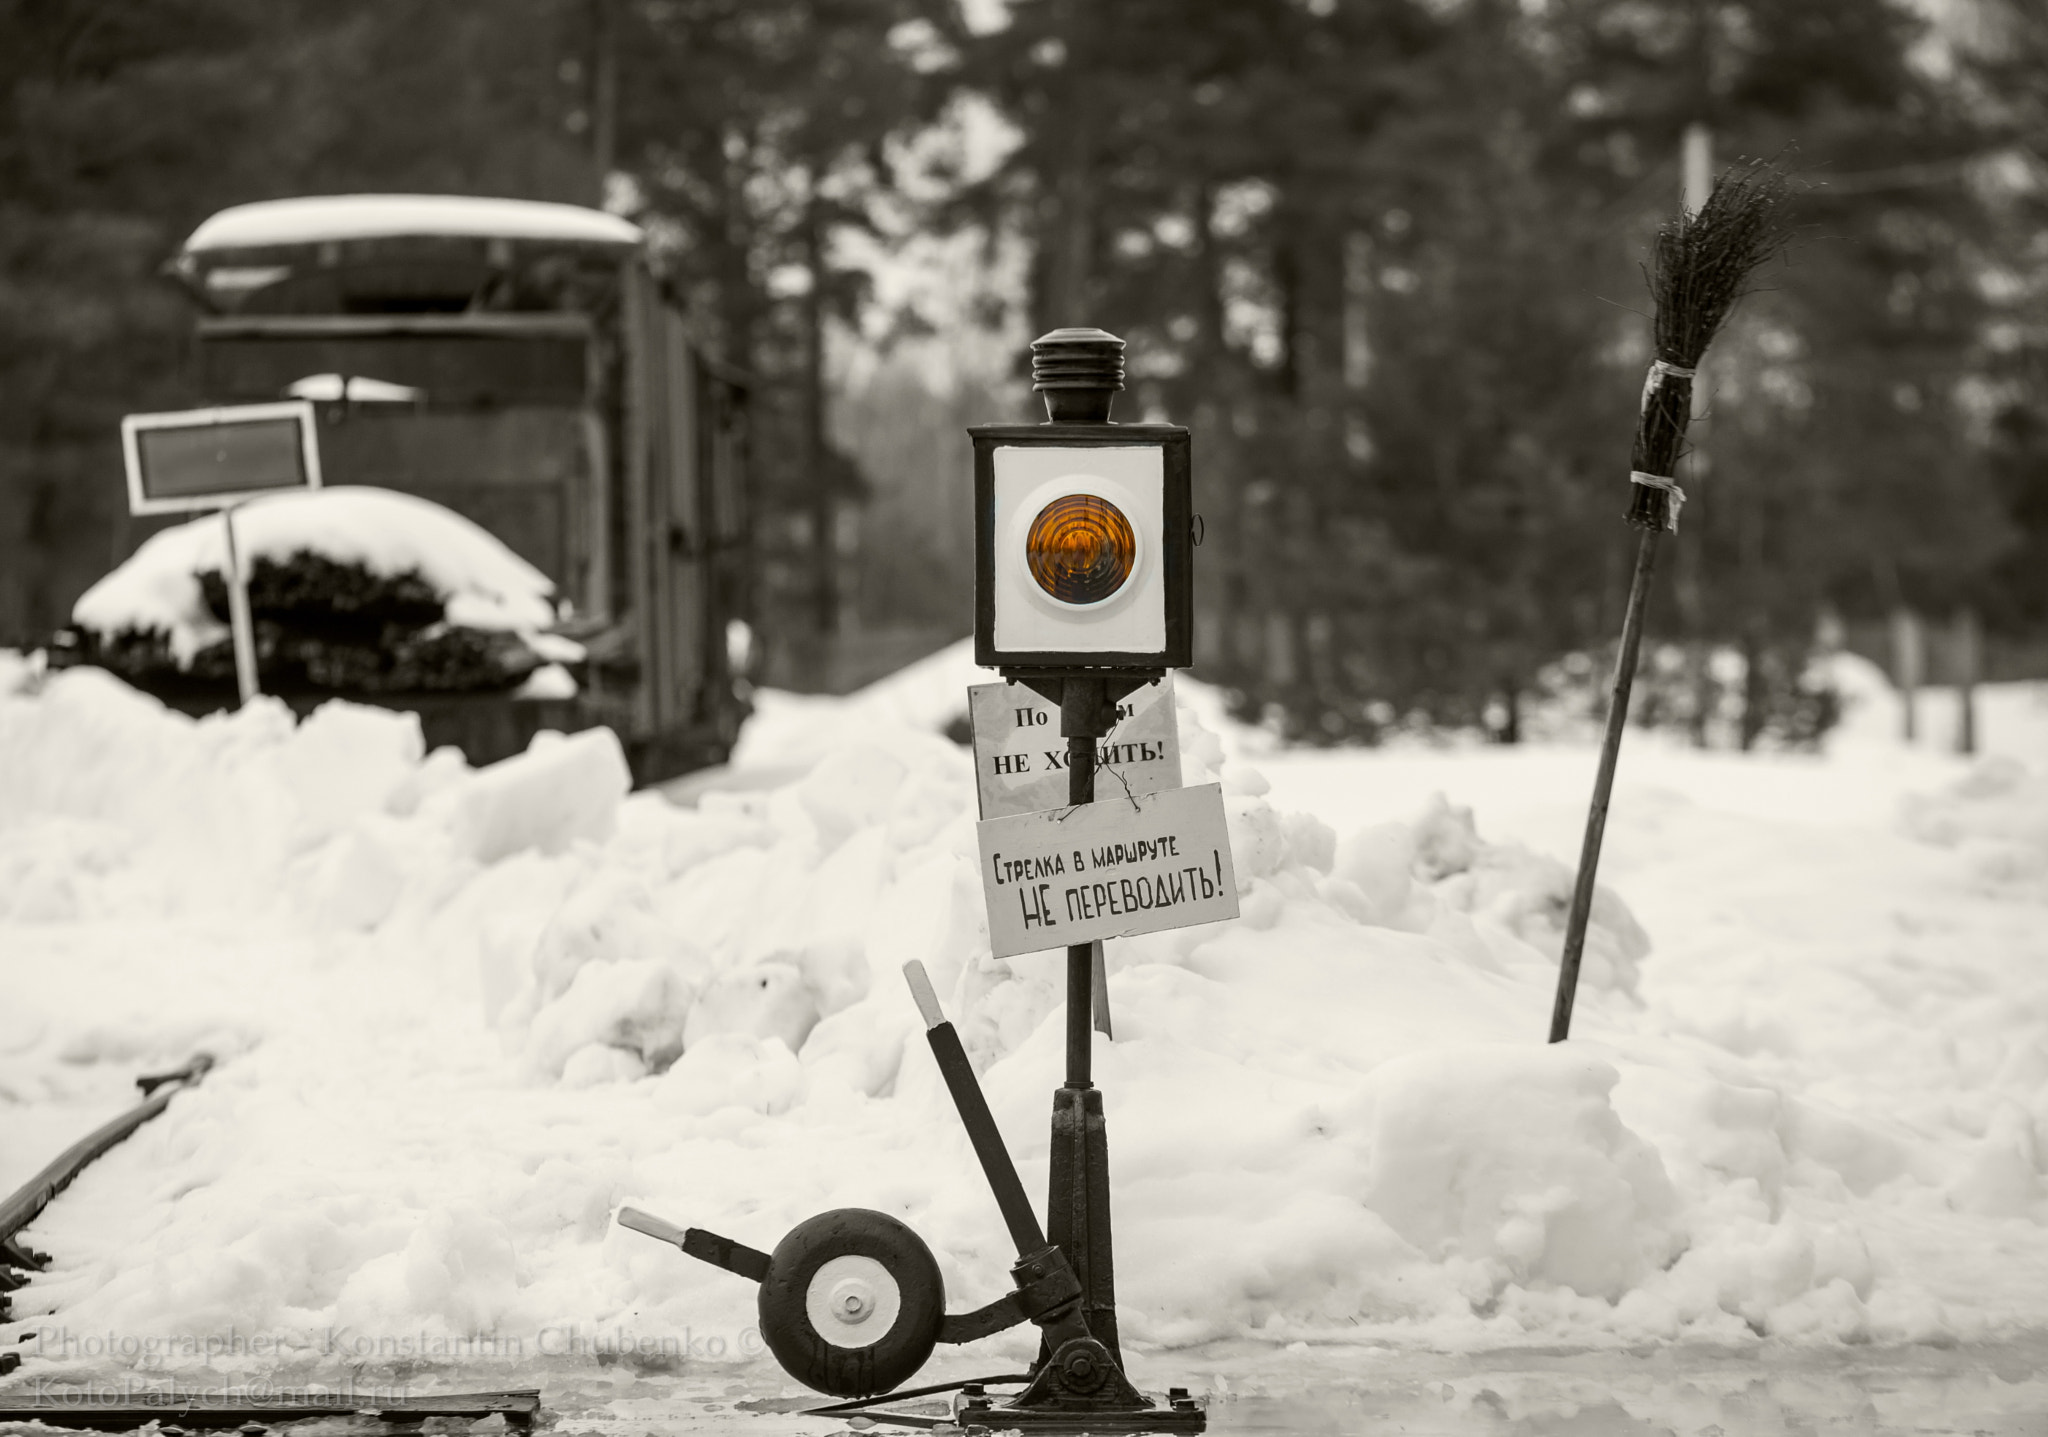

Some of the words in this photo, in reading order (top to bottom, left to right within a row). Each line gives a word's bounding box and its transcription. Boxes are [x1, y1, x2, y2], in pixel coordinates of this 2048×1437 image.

[1014, 707, 1048, 728] По
[992, 753, 1031, 776] НЕ
[1019, 883, 1057, 930] НЕ
[1065, 849, 1224, 922] ПЕРЕВОДИТЬ!
